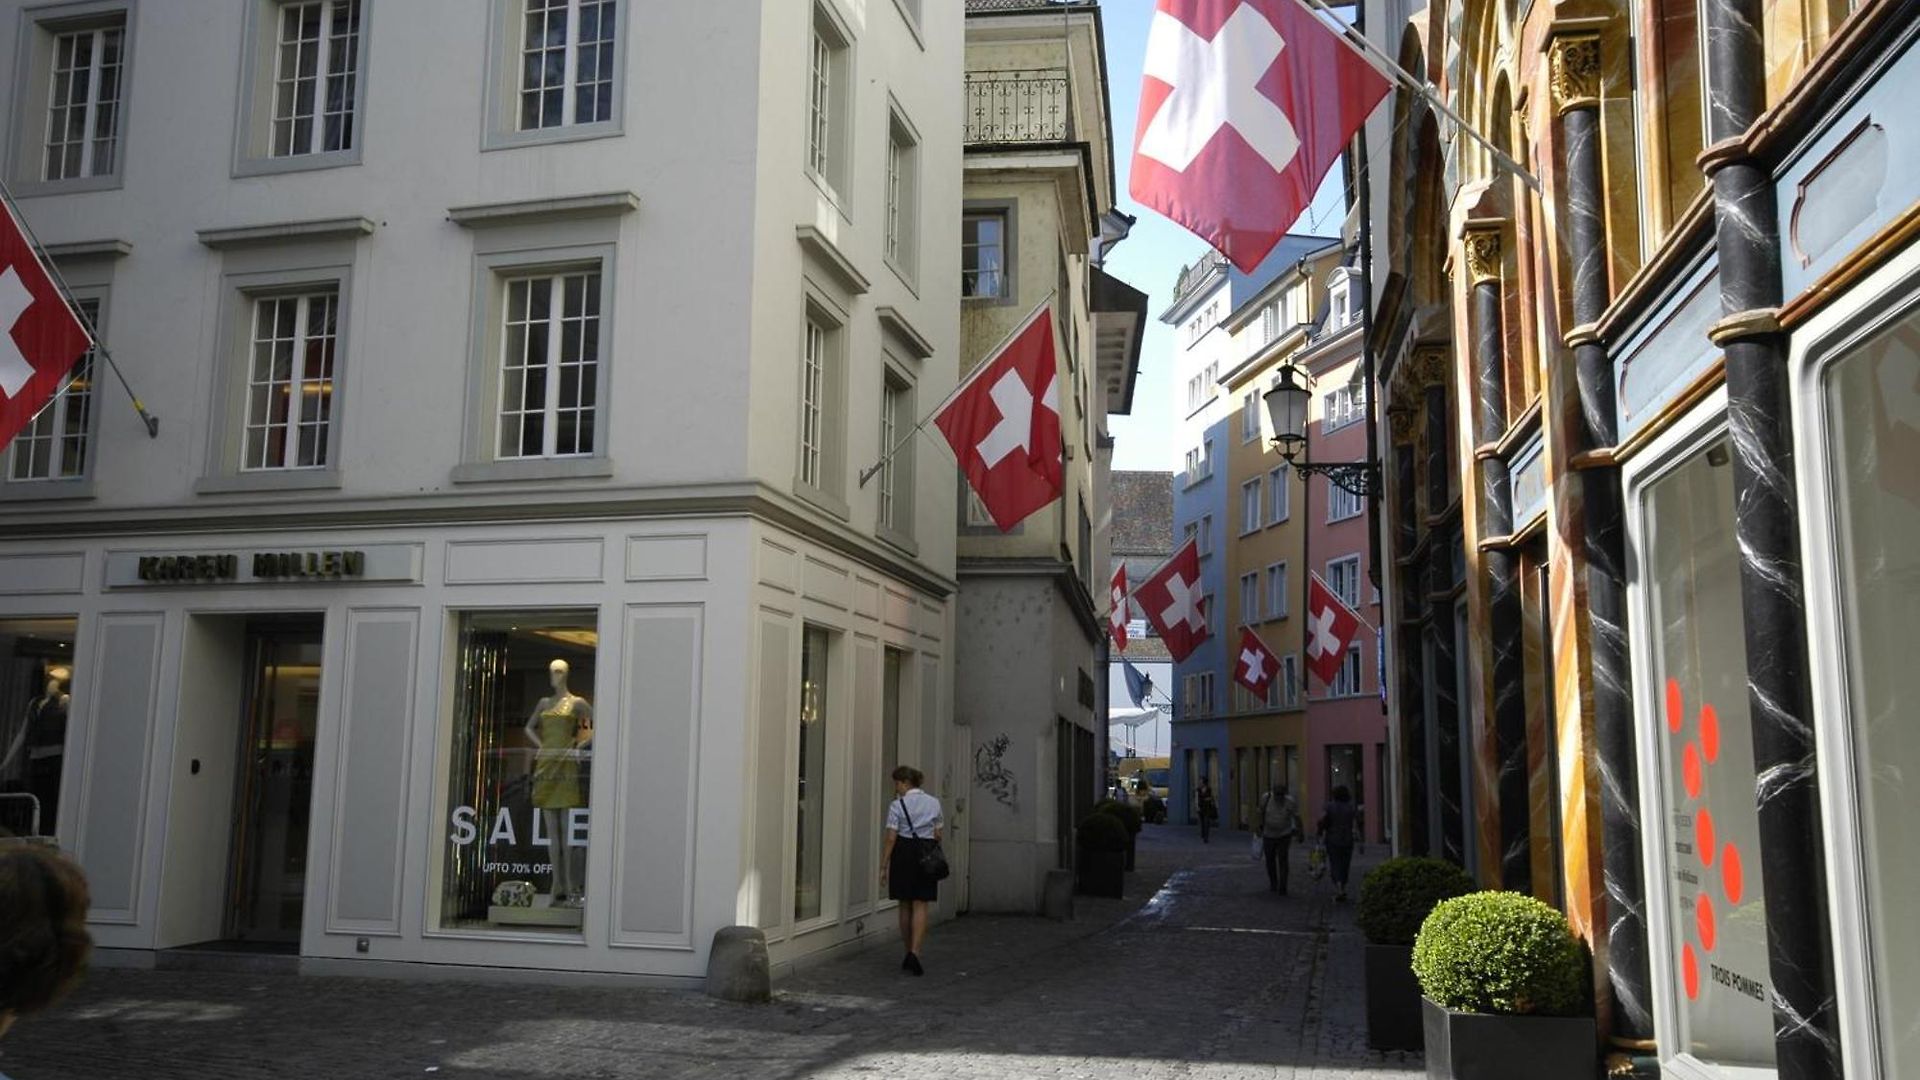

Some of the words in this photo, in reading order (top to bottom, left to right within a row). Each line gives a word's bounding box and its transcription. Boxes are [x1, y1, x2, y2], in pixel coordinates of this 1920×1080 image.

[138, 555, 238, 580] KAREN
[253, 551, 364, 577] MILLEN
[450, 806, 590, 846] SALE
[512, 863, 530, 874] 70%
[533, 863, 553, 874] OFF
[1711, 963, 1730, 987] TROIS
[1732, 972, 1764, 1001] POMMES
